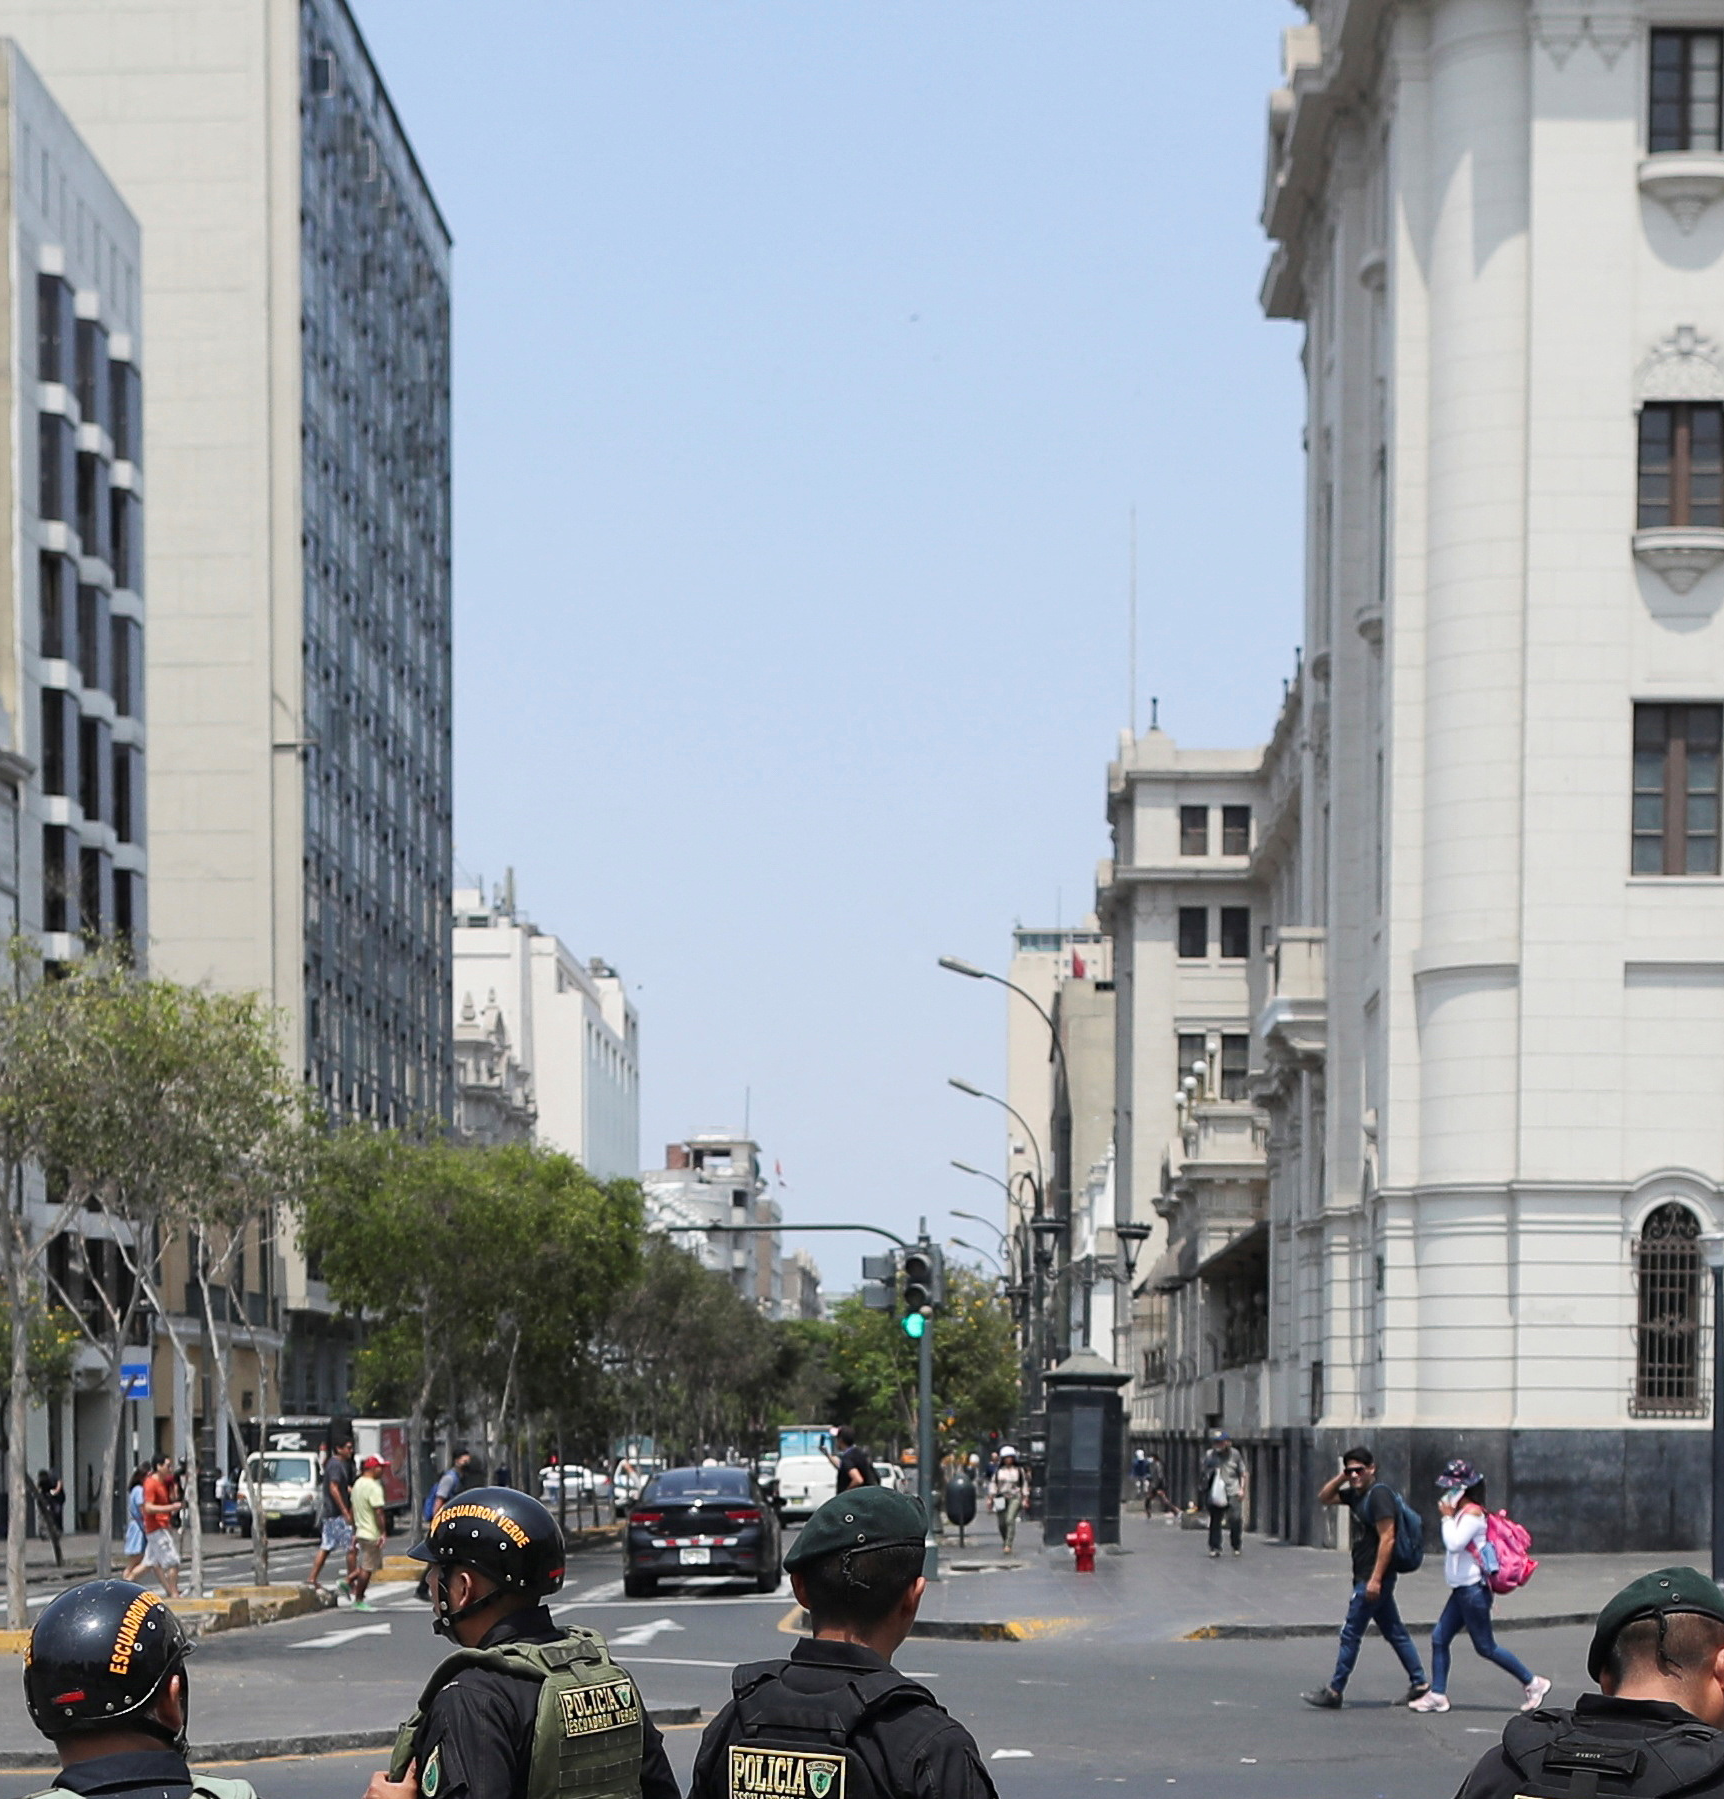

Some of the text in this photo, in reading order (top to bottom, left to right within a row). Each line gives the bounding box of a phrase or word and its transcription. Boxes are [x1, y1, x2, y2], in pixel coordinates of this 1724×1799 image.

[441, 1504, 499, 1523] ESCUADRON
[496, 1515, 531, 1549] VERDE
[109, 1595, 150, 1675] ESCUADRON
[562, 1687, 621, 1719] POLICIA
[732, 1752, 807, 1796] POLICIA
